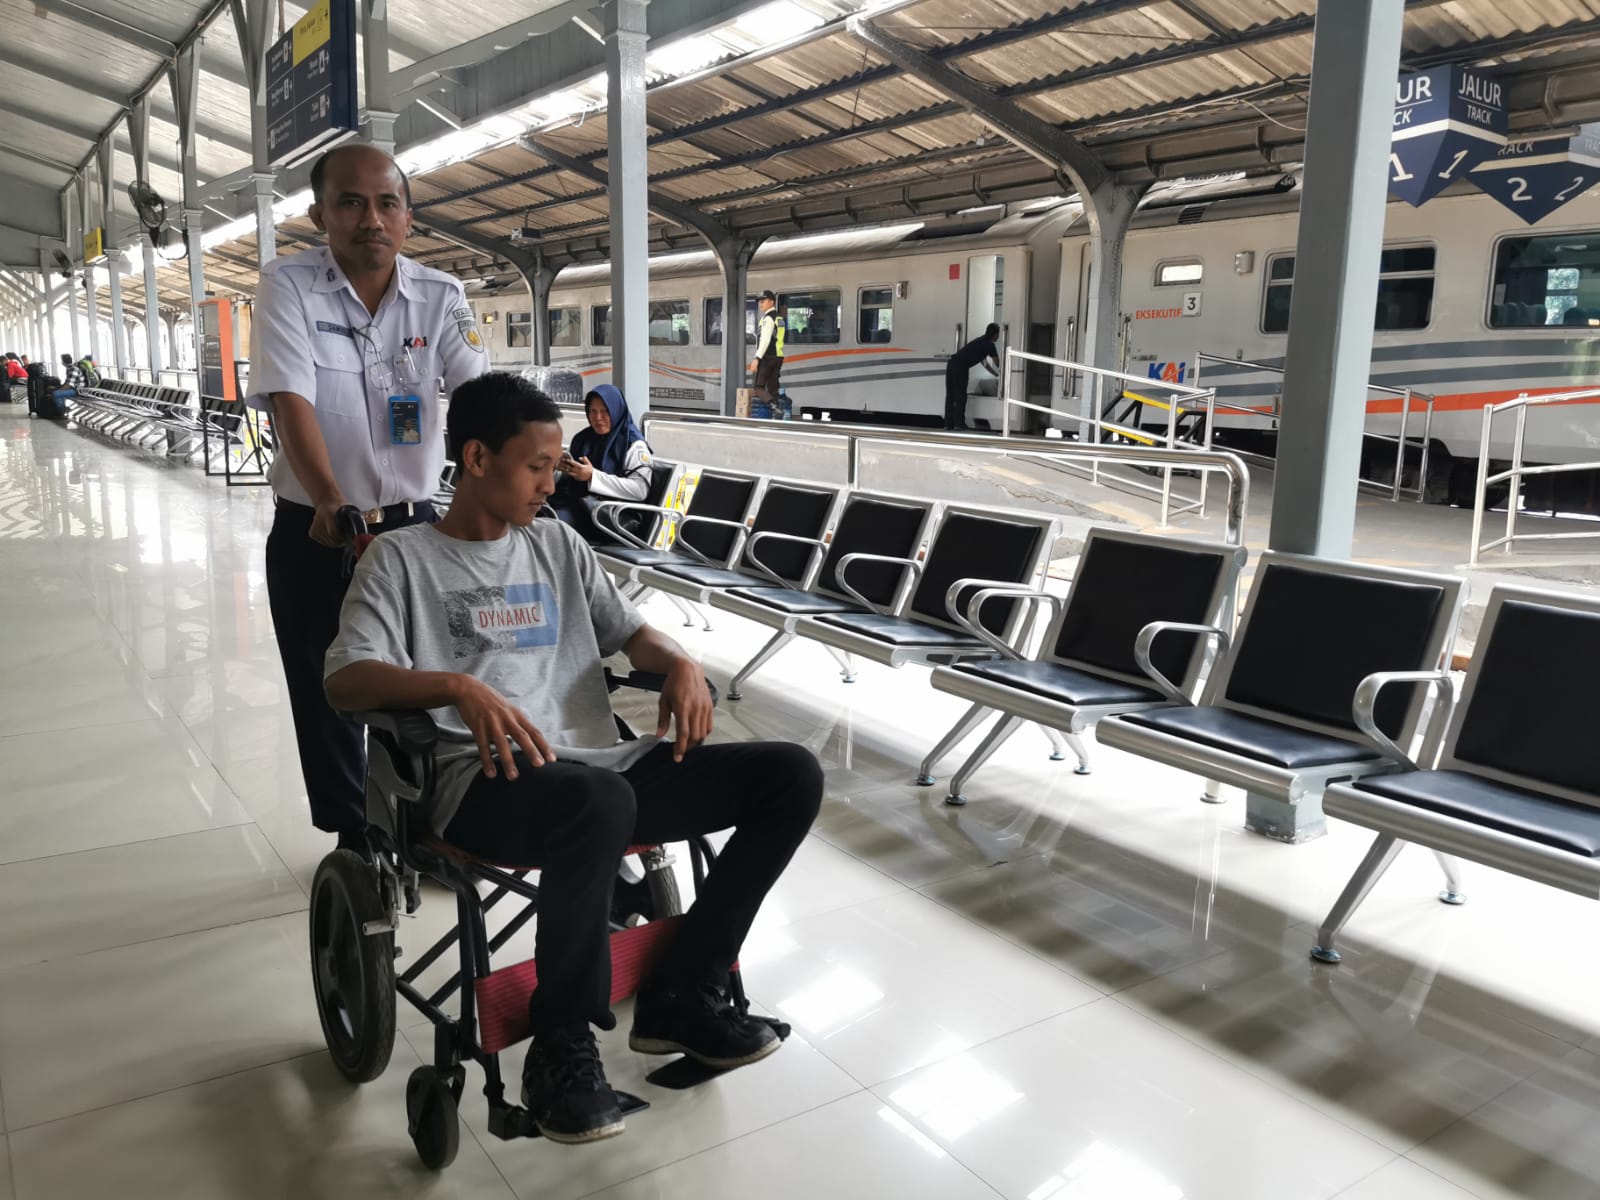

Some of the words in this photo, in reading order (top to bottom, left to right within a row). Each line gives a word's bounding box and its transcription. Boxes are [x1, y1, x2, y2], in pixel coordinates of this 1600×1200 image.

[1396, 76, 1433, 104] UR
[1459, 72, 1502, 107] JALUR
[1467, 104, 1492, 125] TRACK
[1497, 141, 1534, 156] RACK
[1389, 152, 1414, 182] 1
[1438, 149, 1469, 180] 1
[1507, 177, 1533, 202] 2
[1553, 175, 1584, 201] 2
[1135, 307, 1182, 320] EKSEKUTIF
[1187, 297, 1197, 311] 3
[1148, 361, 1186, 384] KAI
[478, 606, 541, 628] DYNAMIC
